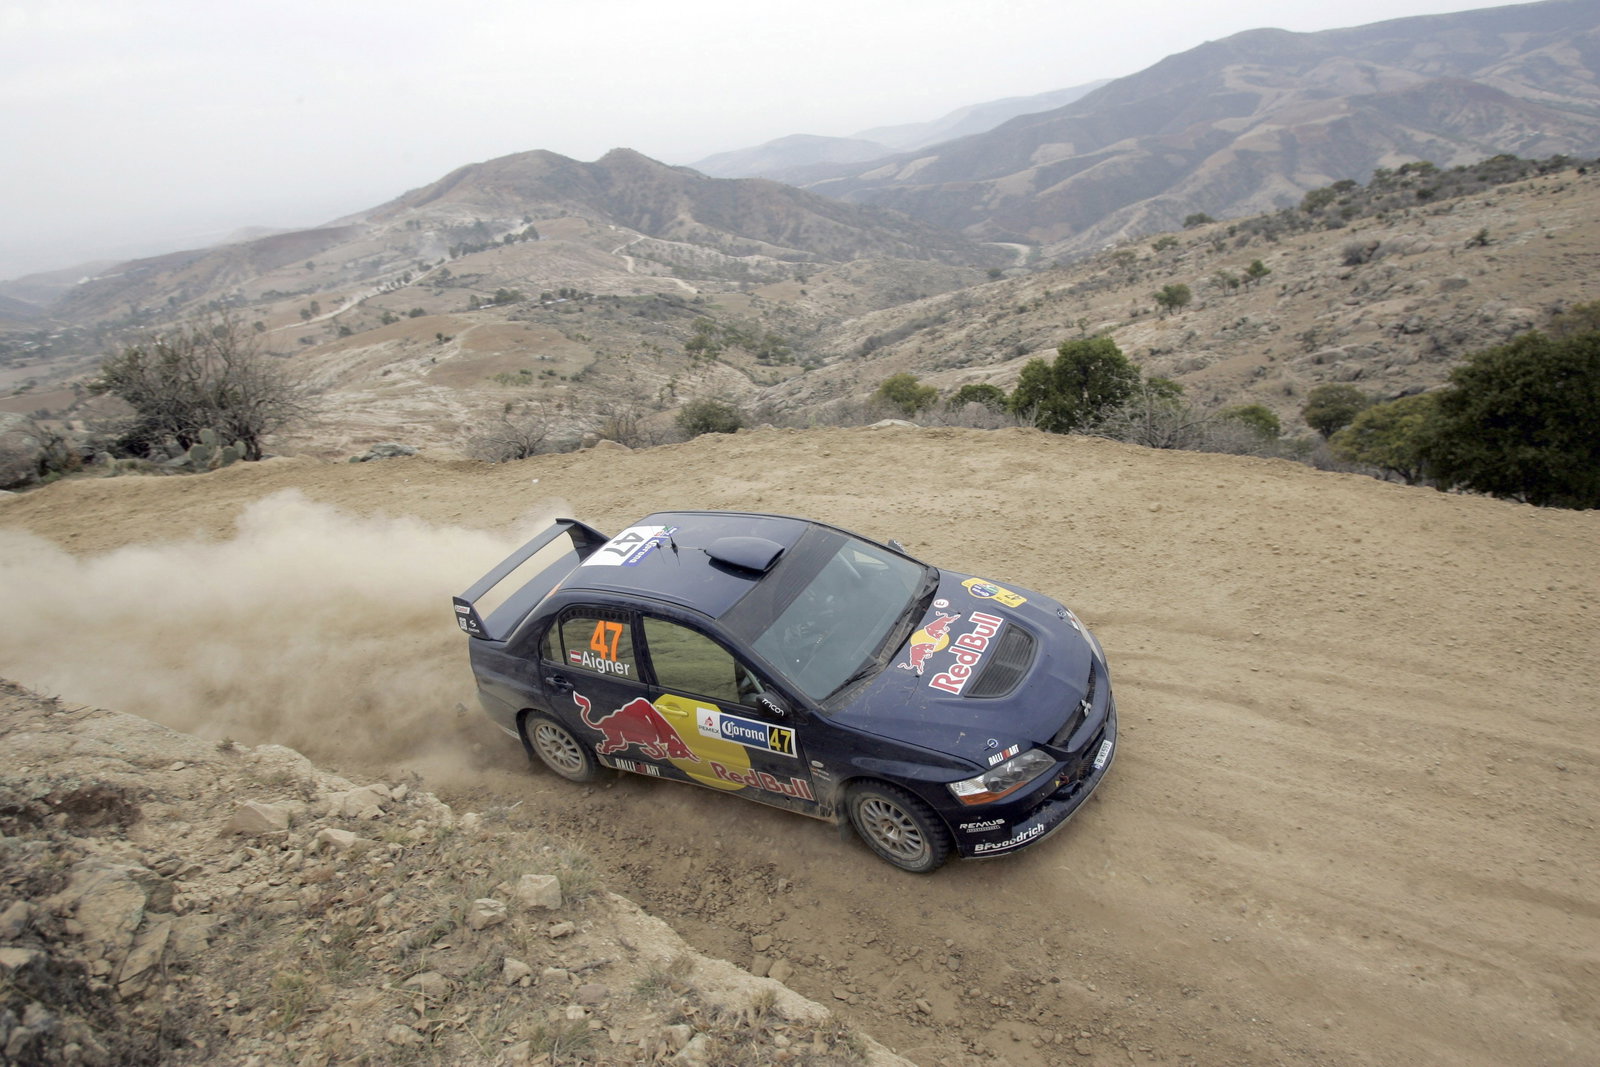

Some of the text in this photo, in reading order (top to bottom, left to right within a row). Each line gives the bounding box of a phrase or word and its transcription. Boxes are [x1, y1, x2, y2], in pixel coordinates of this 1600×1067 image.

[603, 532, 645, 557] 47
[590, 620, 623, 662] 47
[928, 611, 1004, 695] Red Bull
[581, 650, 630, 676] Aigner
[698, 725, 720, 735] PEMEX
[721, 721, 766, 743] Corona
[769, 728, 792, 753] 47
[710, 762, 815, 801] Red Bull
[959, 818, 1005, 830] REMUS
[974, 822, 1045, 850] BFGoodrich
